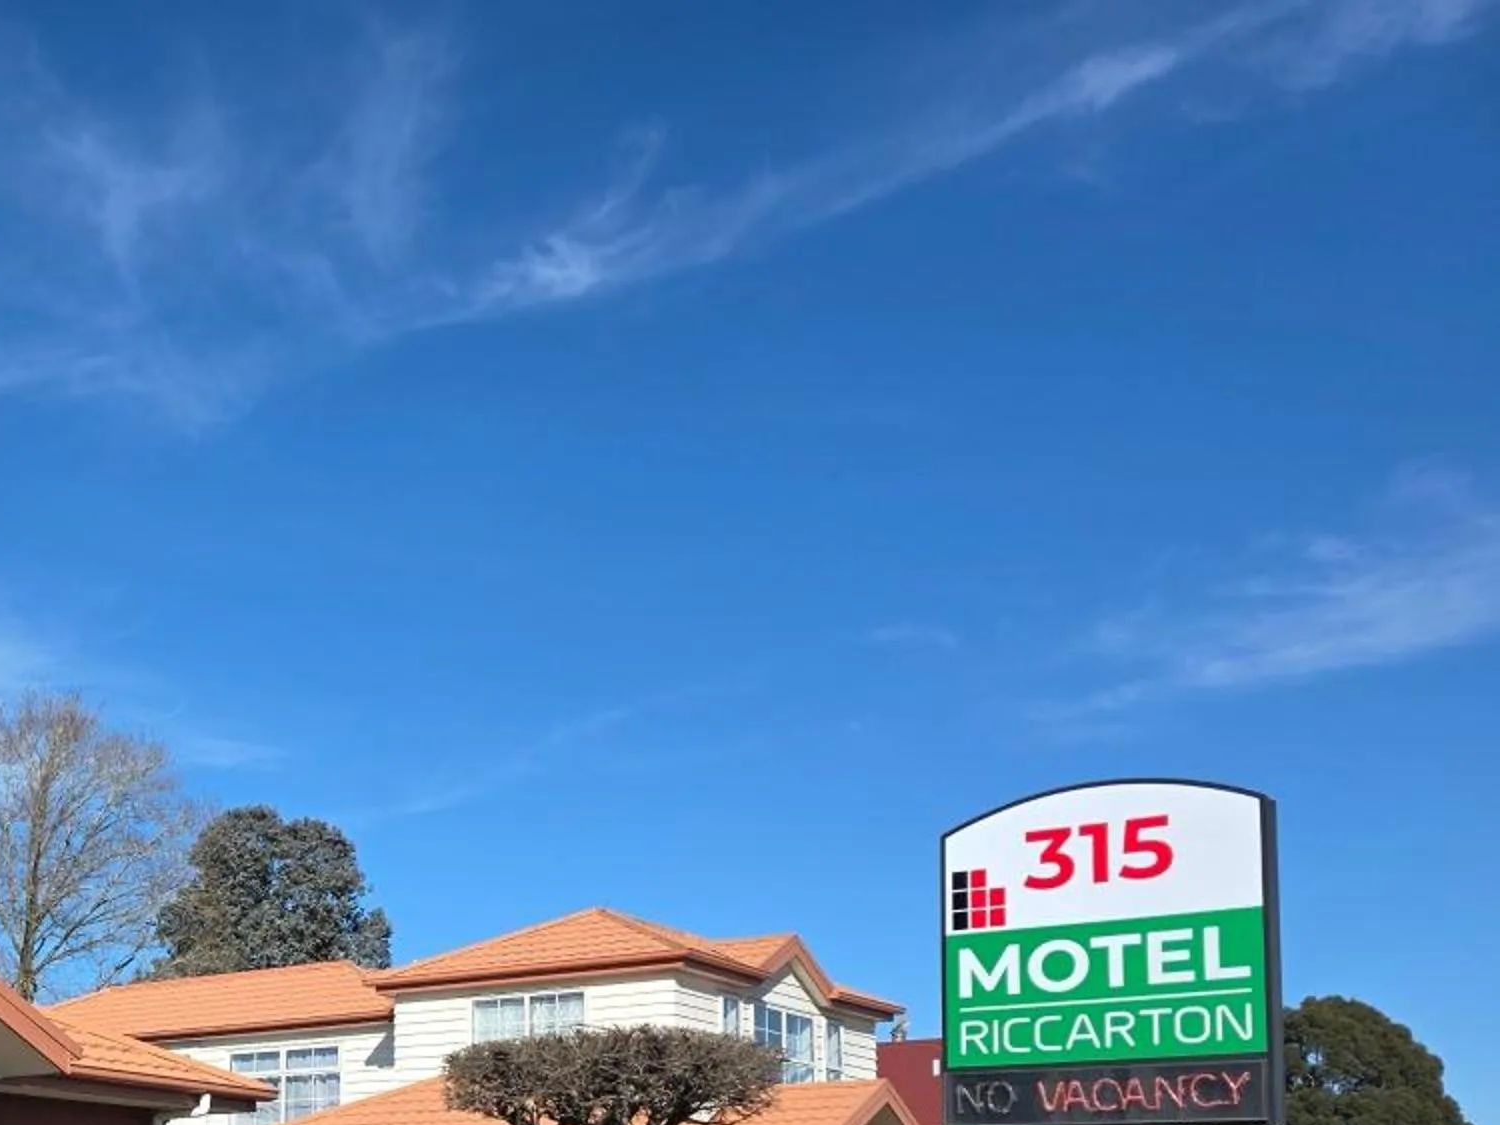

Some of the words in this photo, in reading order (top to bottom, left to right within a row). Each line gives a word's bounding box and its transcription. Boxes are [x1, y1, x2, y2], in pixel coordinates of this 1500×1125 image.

[1024, 815, 1173, 890] 315
[958, 926, 1252, 999] MOTEL
[960, 1003, 1253, 1055] RICCARTON
[955, 1081, 1016, 1114] NO
[1037, 1071, 1251, 1112] VACANCY
